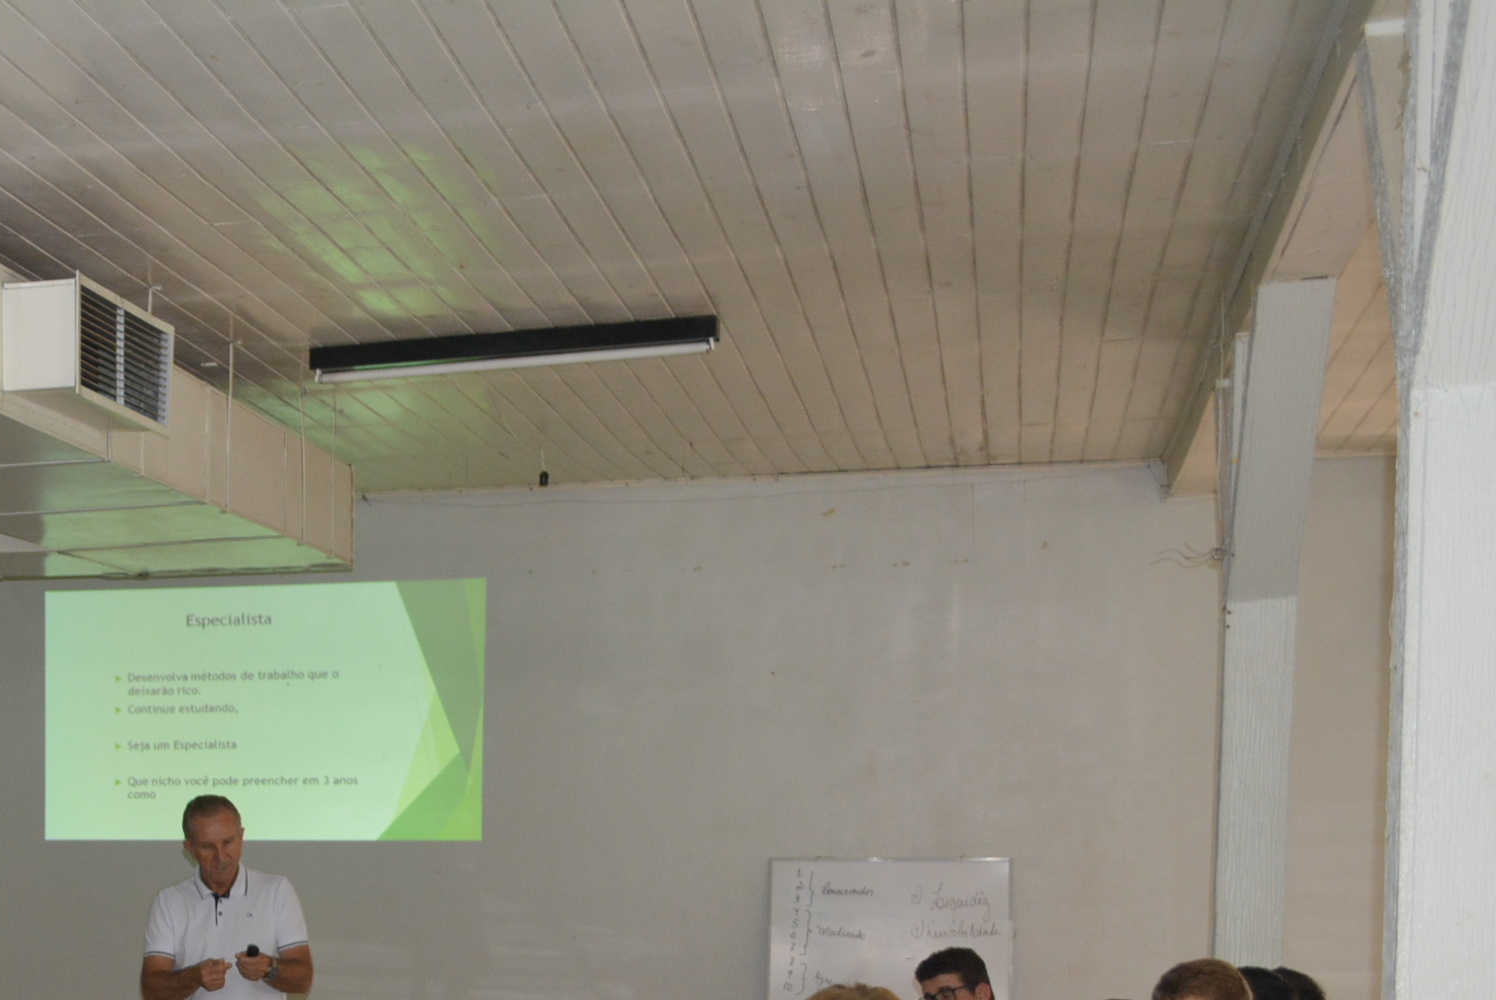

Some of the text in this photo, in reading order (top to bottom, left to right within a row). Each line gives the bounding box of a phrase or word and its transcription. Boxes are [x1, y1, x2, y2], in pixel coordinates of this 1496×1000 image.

[186, 612, 273, 630] Especialista
[127, 669, 340, 682] Desenvolva métodos de trabalho que o
[127, 685, 202, 697] deixarão rico.
[127, 702, 239, 715] Continue estudando,
[127, 739, 238, 752] Seja um Especialista
[127, 774, 359, 788] Que nicho você pode preencher em 3 anos
[127, 790, 157, 800] como
